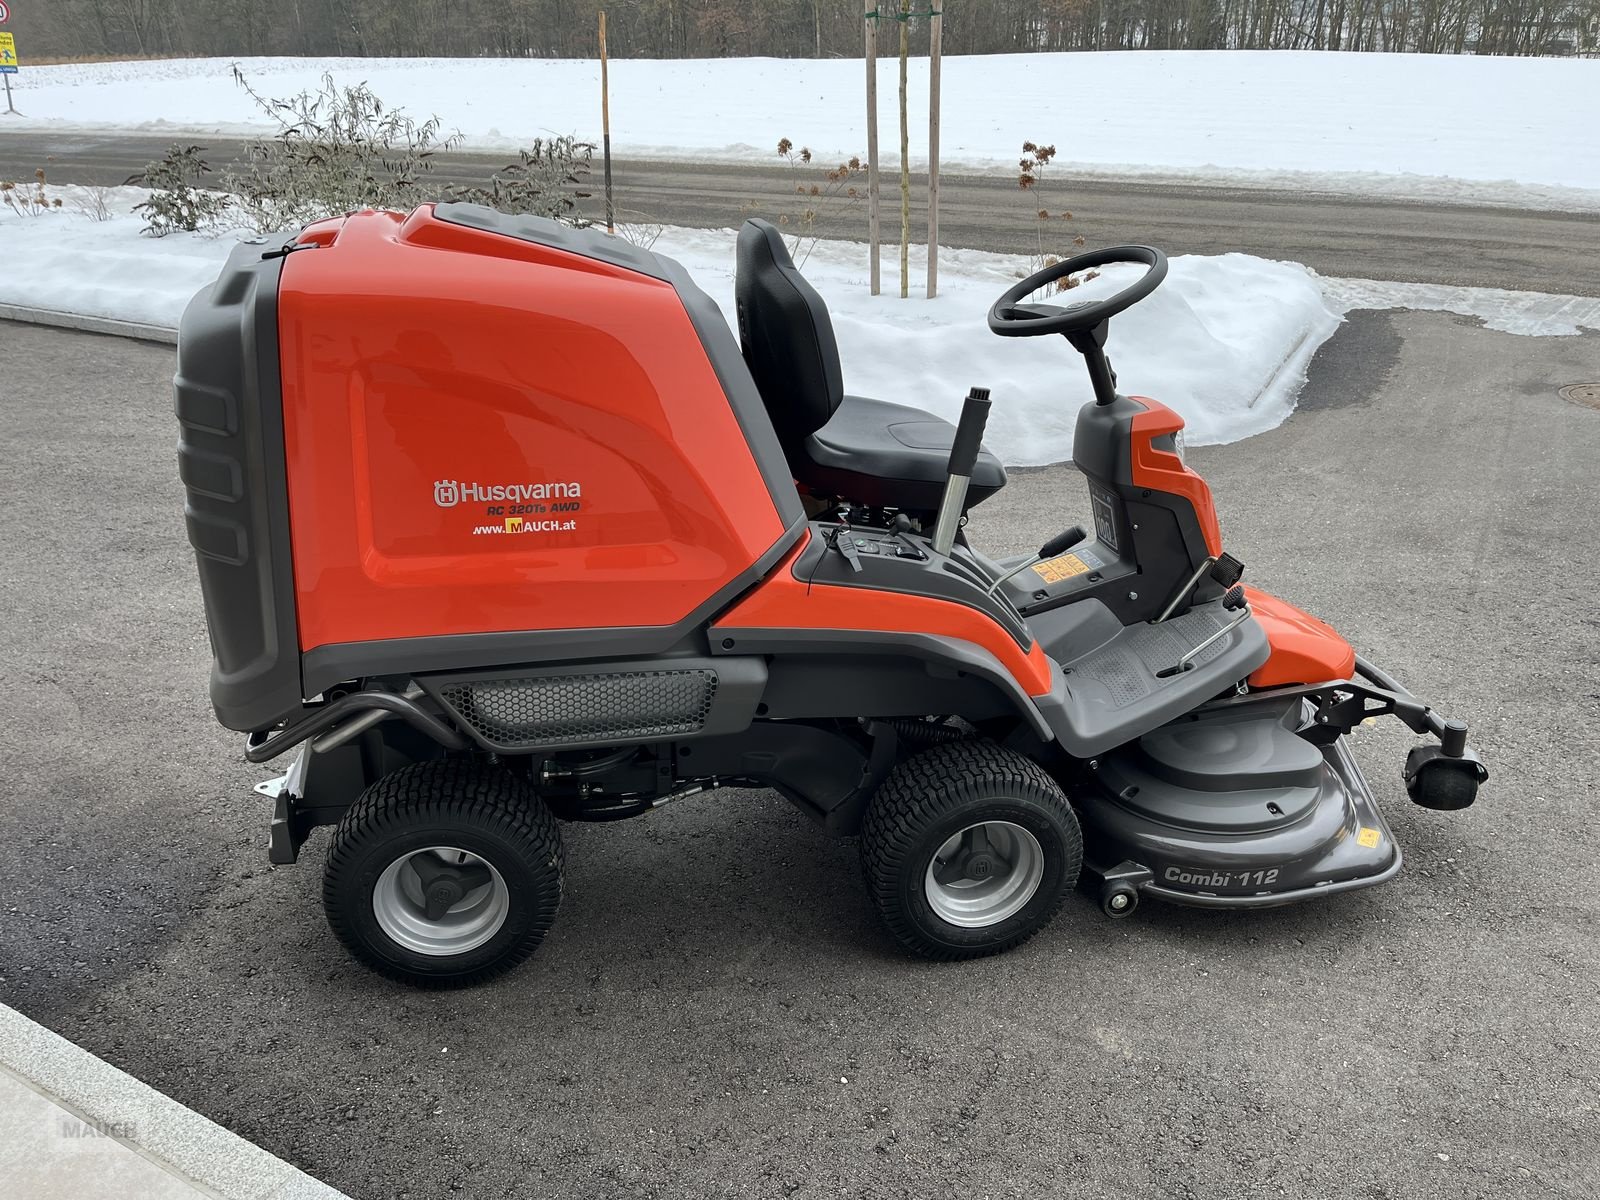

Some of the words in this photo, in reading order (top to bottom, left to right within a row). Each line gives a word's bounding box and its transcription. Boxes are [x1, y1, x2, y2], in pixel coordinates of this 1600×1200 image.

[460, 482, 581, 503] Husqvarna
[487, 506, 504, 516] RC
[551, 501, 580, 512] AWD
[473, 518, 576, 535] www.MAUCH.at
[1164, 866, 1231, 887] Combi
[1239, 868, 1279, 886] 112
